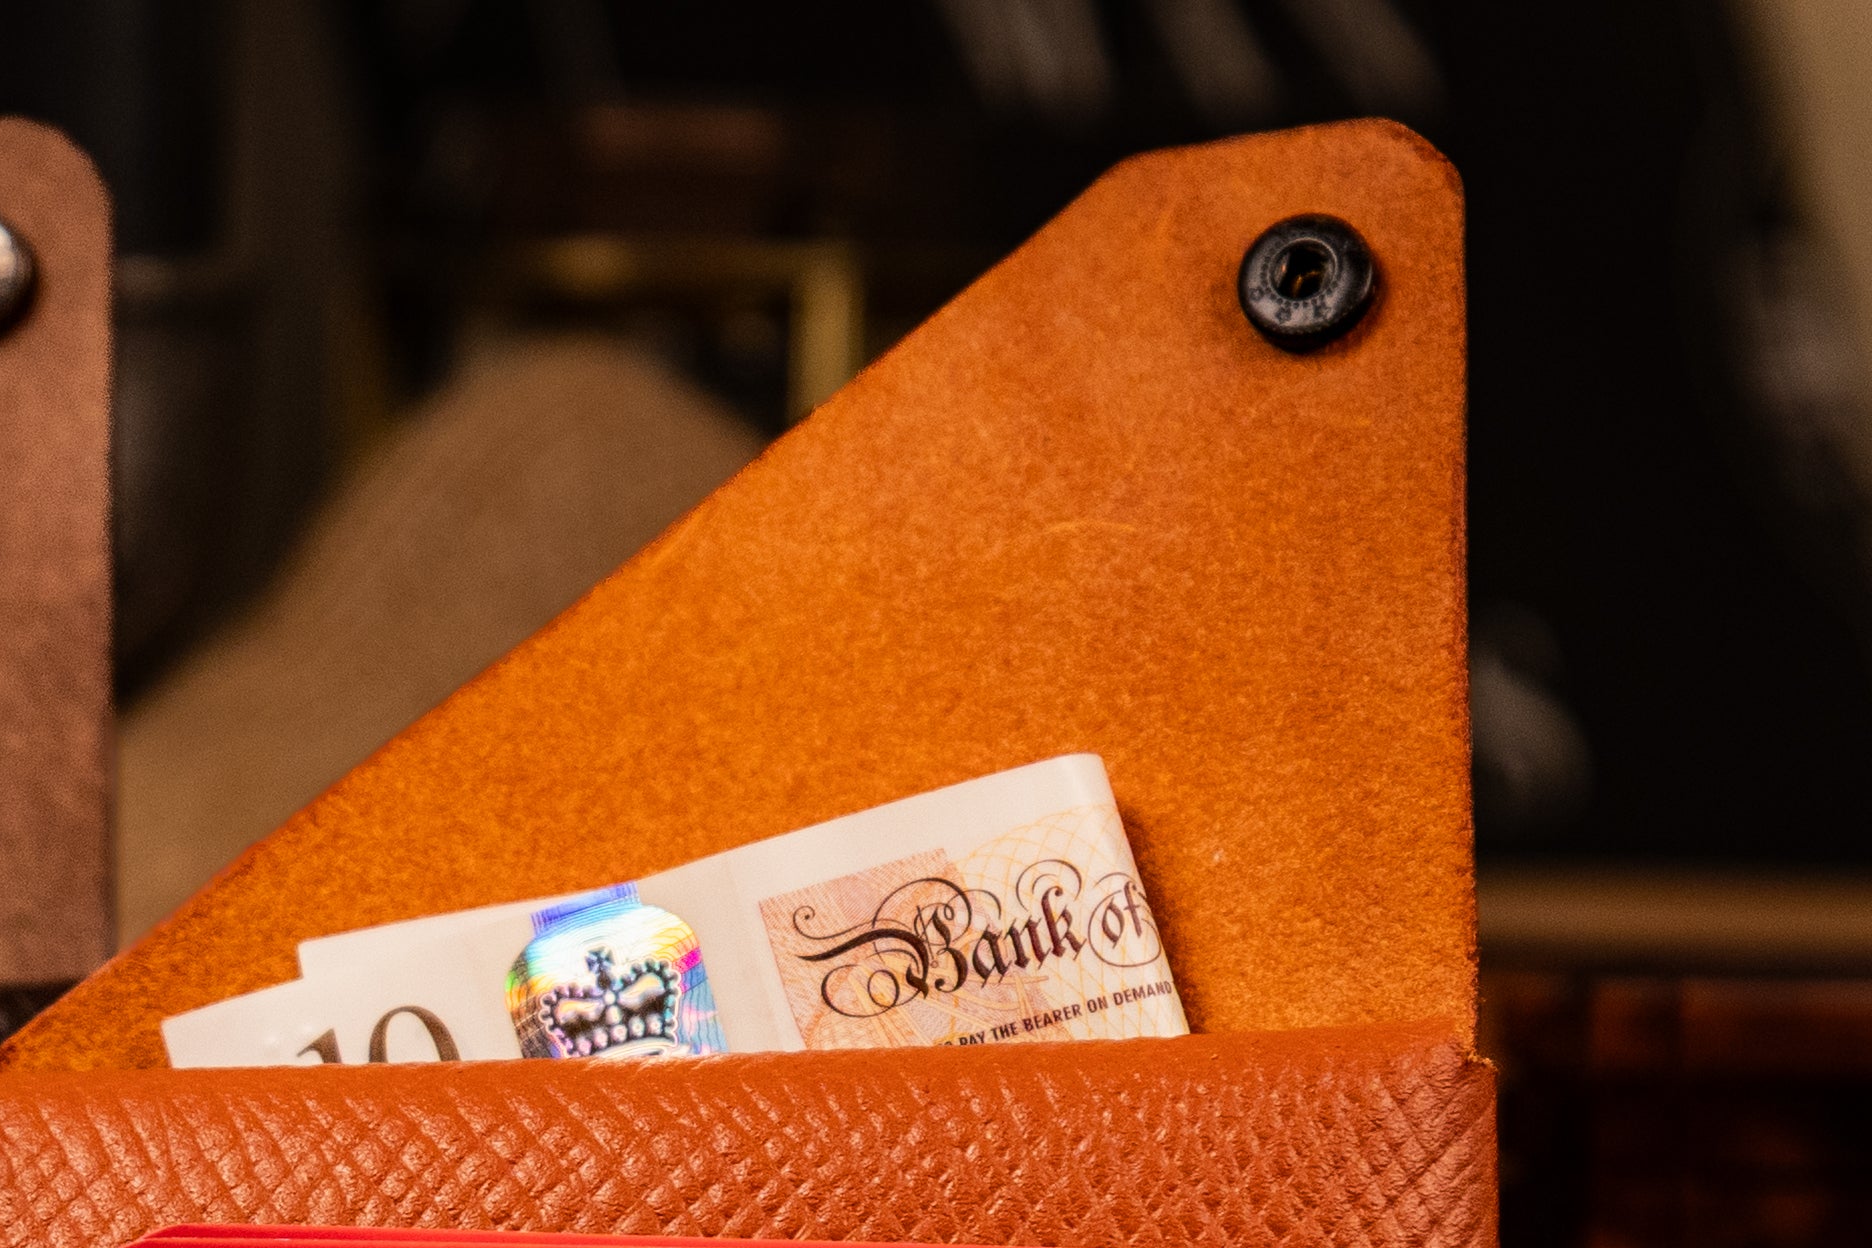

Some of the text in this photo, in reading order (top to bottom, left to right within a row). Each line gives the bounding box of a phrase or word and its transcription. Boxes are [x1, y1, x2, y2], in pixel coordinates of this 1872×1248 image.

[792, 859, 1086, 1018] Bank
[990, 1021, 1019, 1041] THE
[1023, 1003, 1082, 1033] BEARER
[1087, 996, 1109, 1014] ON
[1113, 980, 1173, 1006] DEMAND
